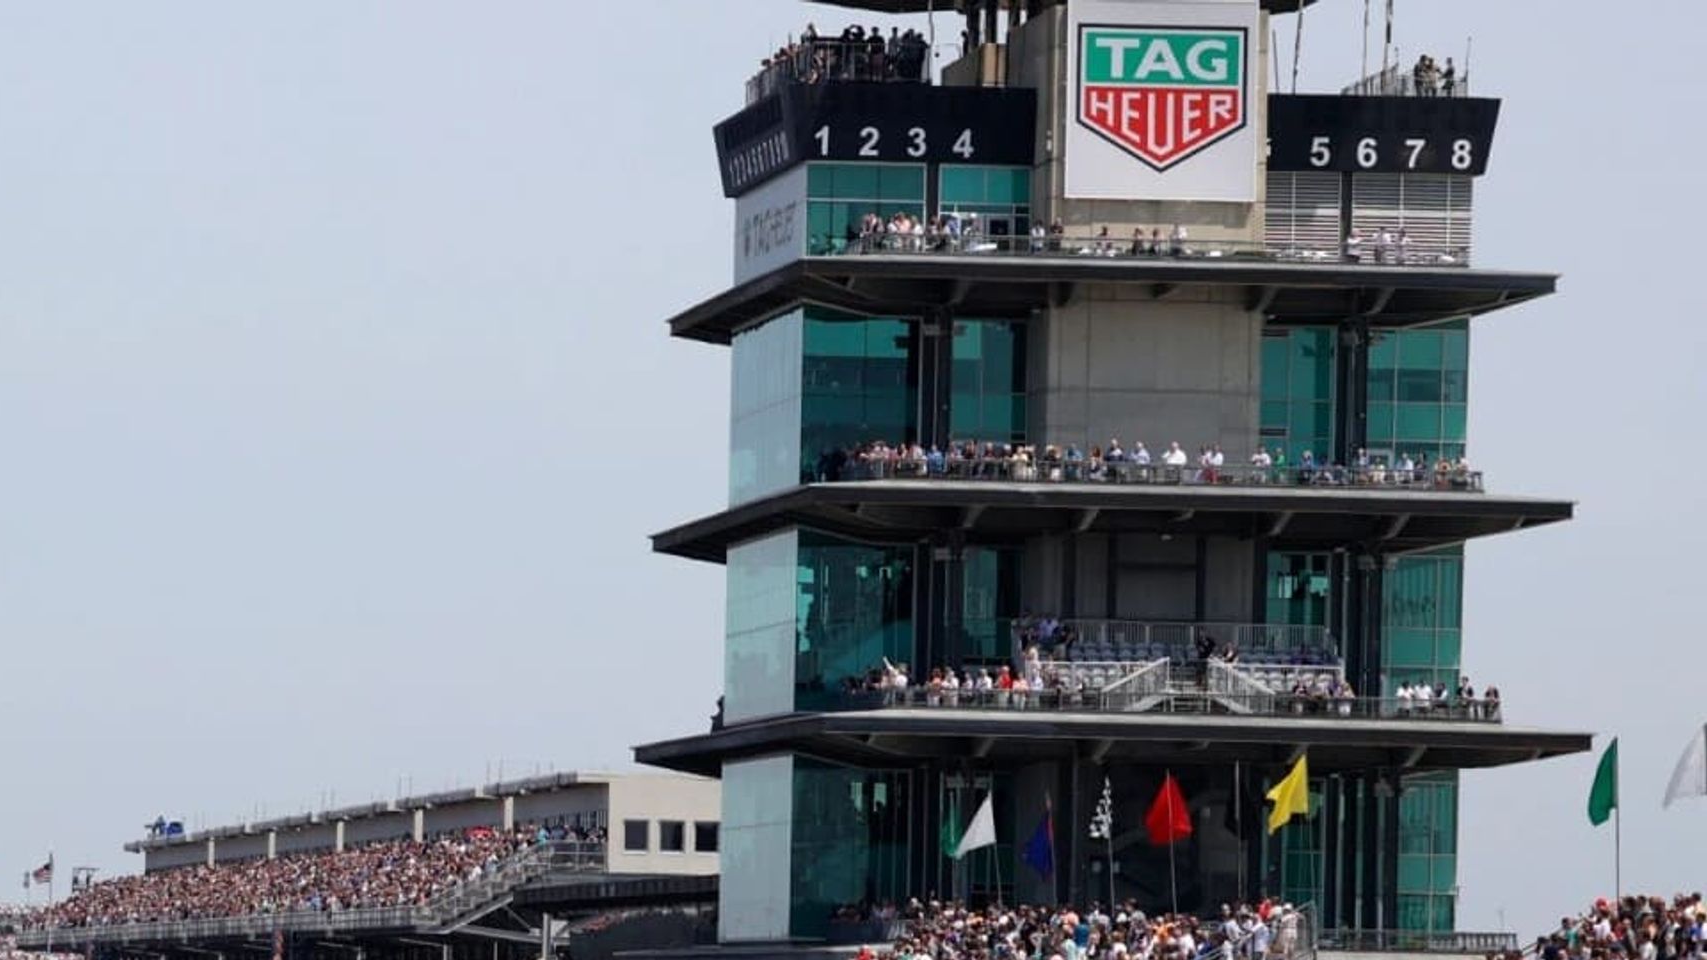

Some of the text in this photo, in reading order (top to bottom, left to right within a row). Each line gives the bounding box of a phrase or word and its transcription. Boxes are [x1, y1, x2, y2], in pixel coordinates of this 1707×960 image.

[1096, 37, 1228, 81] TAG
[814, 125, 974, 158] 1 2 3 4
[1090, 91, 1234, 156] HEUER
[1310, 136, 1472, 170] 5 6 7 8
